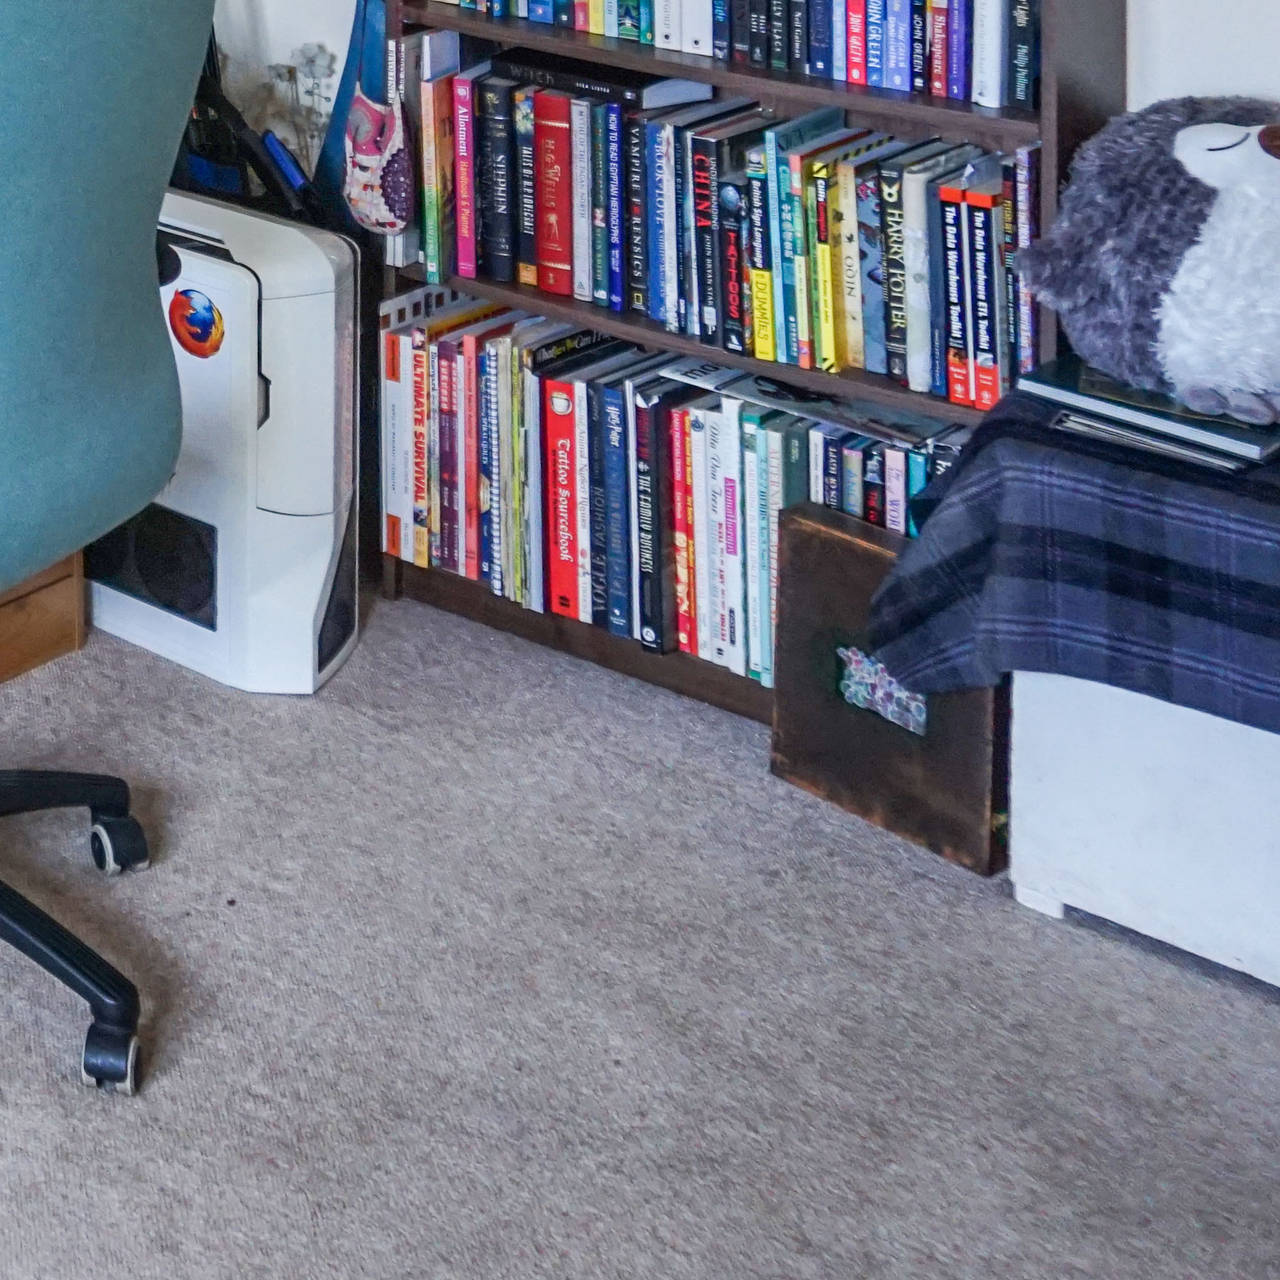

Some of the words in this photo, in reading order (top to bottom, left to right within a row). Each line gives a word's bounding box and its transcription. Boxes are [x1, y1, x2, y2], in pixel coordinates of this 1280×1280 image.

[794, 11, 803, 29] Neil
[849, 11, 863, 33] JOHN
[914, 14, 924, 40] JOHN
[1013, 4, 1028, 27] Lights
[793, 29, 803, 59] Gaiman
[850, 34, 863, 63] GREEN
[868, 25, 883, 68] GREEN
[914, 41, 923, 73] GREEN
[932, 15, 947, 76] Shakespeare
[1013, 44, 1030, 65] Philip
[1015, 66, 1028, 100] Pullman
[458, 105, 469, 157] Allotment
[609, 113, 618, 130] HOW
[610, 130, 618, 142] TO
[522, 146, 535, 168] TALES
[610, 142, 619, 161] READ
[631, 127, 642, 190] VAMPIRE
[655, 143, 667, 182] BOOK
[460, 161, 470, 199] Handbook
[494, 154, 508, 215] STEPHEN
[610, 162, 620, 196] EGYPTIAN
[694, 153, 712, 228] CHINA
[710, 157, 719, 231] UNDERSTANDING
[751, 179, 763, 208] British
[817, 179, 827, 203] Cliffs
[610, 197, 621, 245] HIEROGLYPHS
[655, 188, 666, 224] LOVE
[752, 209, 765, 226] Sign
[944, 206, 957, 224] The
[973, 211, 985, 228] The
[460, 209, 470, 238] Planner
[885, 208, 904, 262] HARRY
[947, 226, 959, 248] Data
[975, 229, 986, 250] Data
[704, 234, 713, 257] JOHN
[753, 227, 767, 270] Language
[705, 258, 714, 286] BRYAN
[727, 231, 741, 320] TATTOOS
[947, 250, 961, 301] Warehouse
[975, 252, 989, 299] Warehouse
[754, 281, 770, 342] DUMMIES
[889, 268, 907, 329] POTTER
[977, 301, 989, 319] ETL
[949, 305, 962, 338] Toolkit
[978, 320, 990, 351] Toolkit
[413, 352, 426, 428] ULTIMATE
[606, 405, 623, 426] Harry
[607, 425, 623, 449] Potter
[710, 423, 721, 450] Dita
[413, 430, 426, 504] SURVIVAL
[558, 438, 574, 486] Tattoo
[639, 475, 652, 491] THE
[557, 488, 575, 564] Sourcebook
[641, 492, 652, 531] FAMILY
[641, 533, 654, 574] BUSINESS
